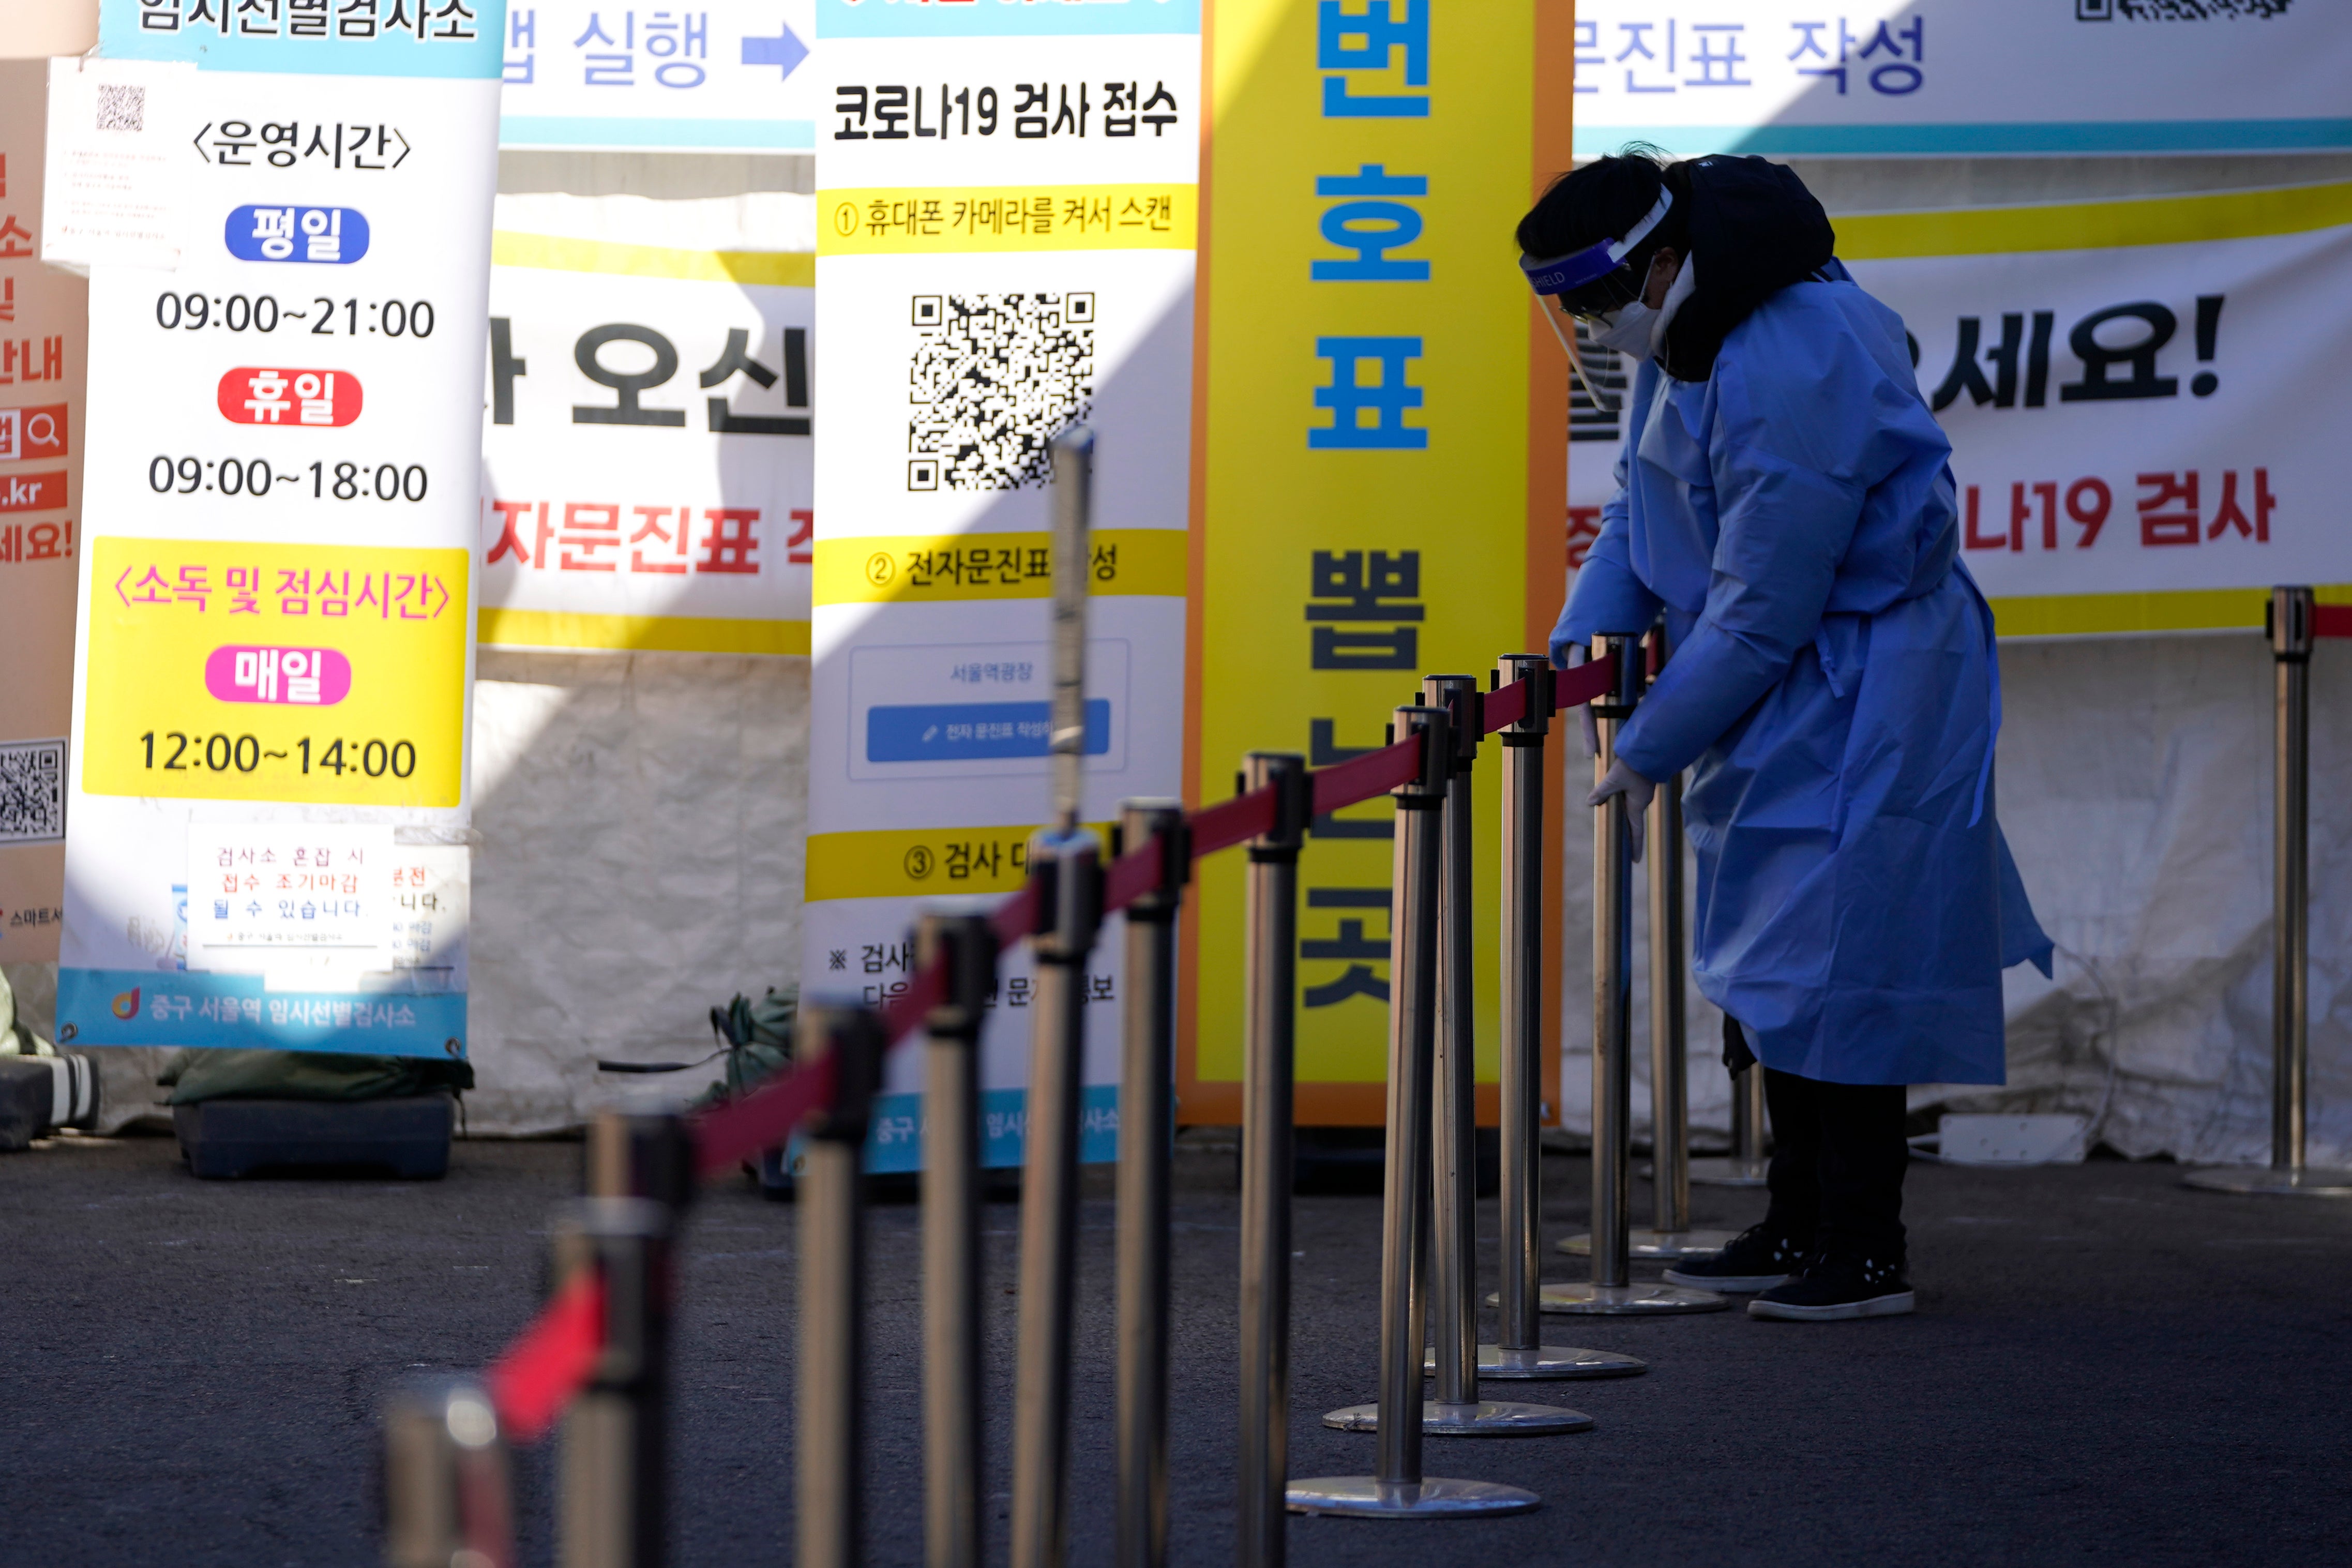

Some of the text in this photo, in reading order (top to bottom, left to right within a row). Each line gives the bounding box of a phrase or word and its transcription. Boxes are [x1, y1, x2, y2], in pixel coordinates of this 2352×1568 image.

[574, 11, 707, 88] 실행
[1788, 16, 1924, 96] 작성
[834, 81, 1178, 140] 코로나19 검사 접수
[251, 207, 342, 262] 평일
[866, 200, 944, 236] 휴대폰
[952, 197, 1056, 235] 카메라를
[1063, 195, 1112, 233] 켜서
[1119, 195, 1173, 232] 스캔
[155, 291, 435, 338] 09:00~21:00
[1906, 293, 2226, 413] 세요!
[244, 369, 335, 425] 휴일
[0, 477, 42, 507] .kr
[148, 455, 428, 502] 09:00~18:00
[2135, 467, 2276, 548] 검사
[480, 496, 762, 576] 자문진표
[225, 566, 261, 615] 및
[234, 649, 322, 703] 매일
[950, 662, 1033, 684] 서울역광장
[139, 730, 416, 779] 12:00~14:00
[217, 846, 364, 867] 검사소 혼잡 시
[944, 841, 1002, 879] 검사
[221, 872, 359, 894] 접수 조기마감
[246, 900, 263, 918] 수
[860, 943, 912, 974] 검사
[149, 994, 416, 1029] 중구 서울역 임시선별검사소
